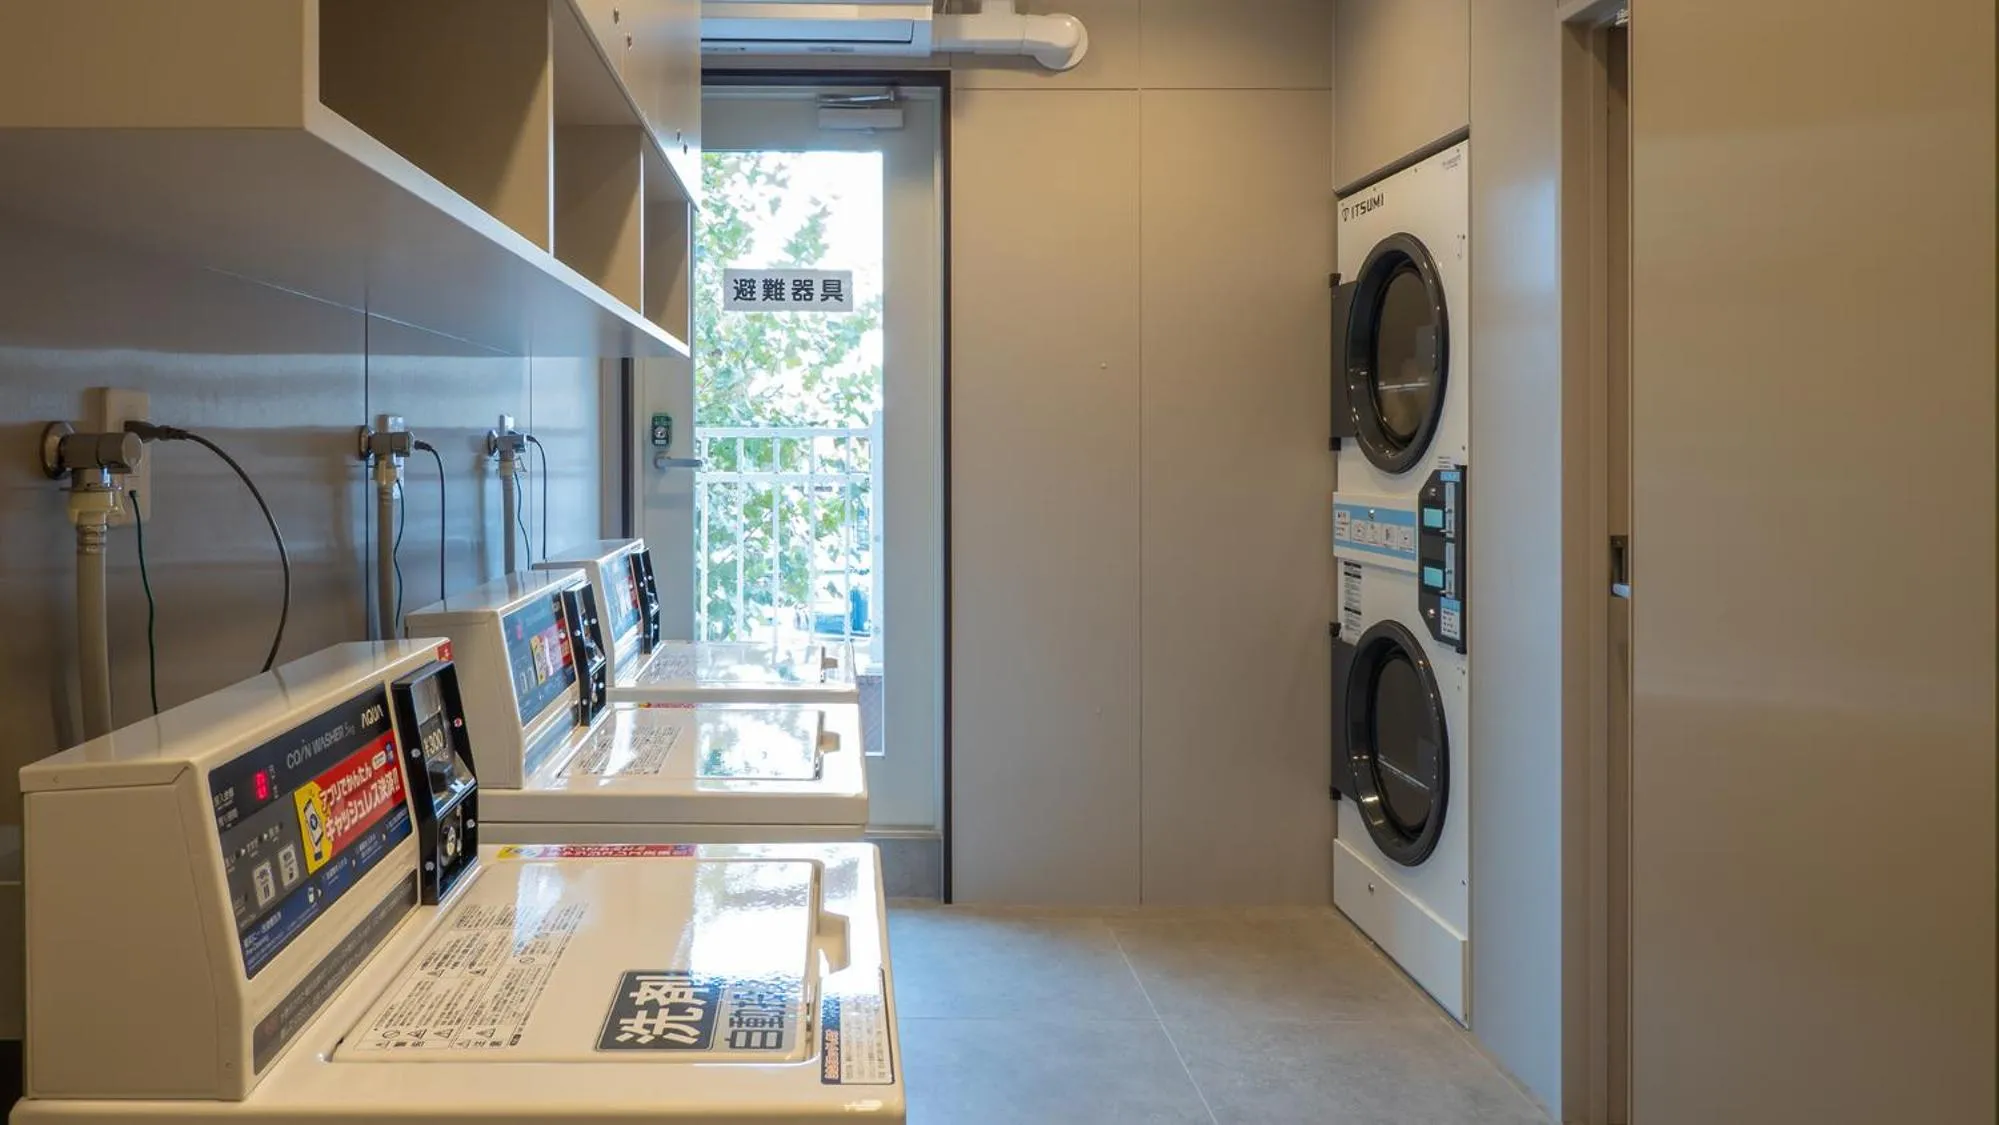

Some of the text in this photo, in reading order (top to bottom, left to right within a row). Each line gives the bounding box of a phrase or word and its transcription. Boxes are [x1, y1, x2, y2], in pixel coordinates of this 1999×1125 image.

[1350, 192, 1385, 219] ITSUMI
[733, 278, 844, 302] 避難器具
[361, 704, 384, 729] AQUA
[286, 738, 312, 769] COIN
[312, 723, 345, 755] WASHER
[319, 762, 373, 811] アプリでかんたん
[614, 974, 707, 1045] 洗剤
